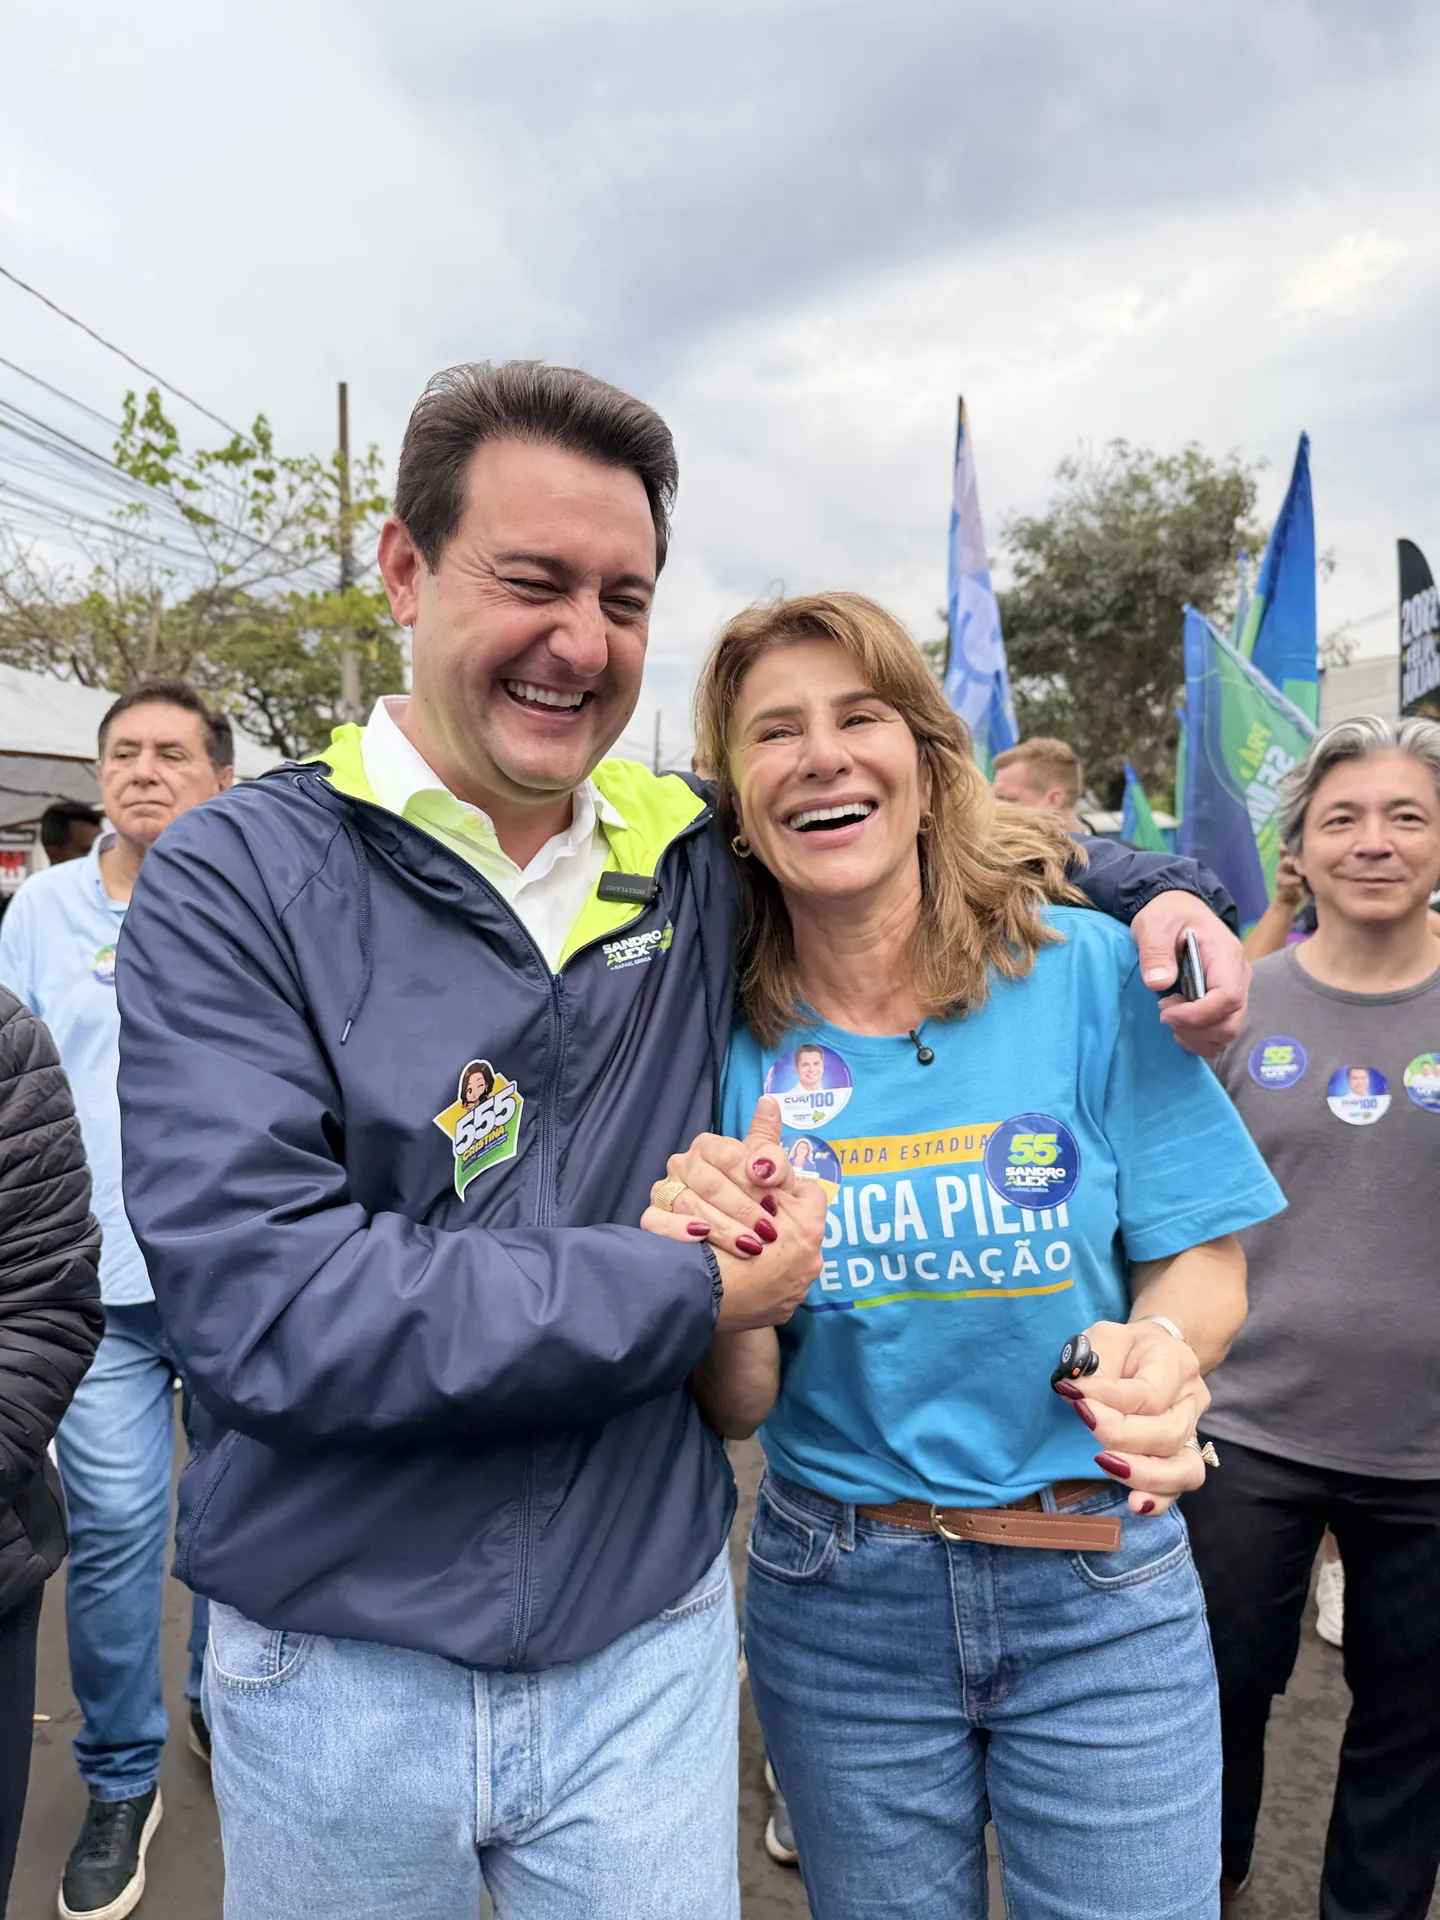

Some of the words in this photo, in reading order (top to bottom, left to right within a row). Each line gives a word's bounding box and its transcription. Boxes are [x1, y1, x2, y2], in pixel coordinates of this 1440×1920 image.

[602, 930, 662, 954] SANDRO
[607, 945, 650, 966] ALEX
[784, 1096, 809, 1104] CURI
[809, 1091, 834, 1108] 100
[455, 1083, 517, 1156] 555
[462, 1125, 505, 1162] CRISTINA
[840, 1147, 888, 1164] TADA
[900, 1134, 987, 1160] ESTADUA
[1007, 1133, 1058, 1165] 55
[1004, 1175, 1049, 1187] ALEX
[1005, 1166, 1066, 1179] SANDRO
[821, 1180, 928, 1248] SICA
[936, 1174, 1069, 1238] PIE
[819, 1239, 1071, 1290] EDUCAÇÃO
